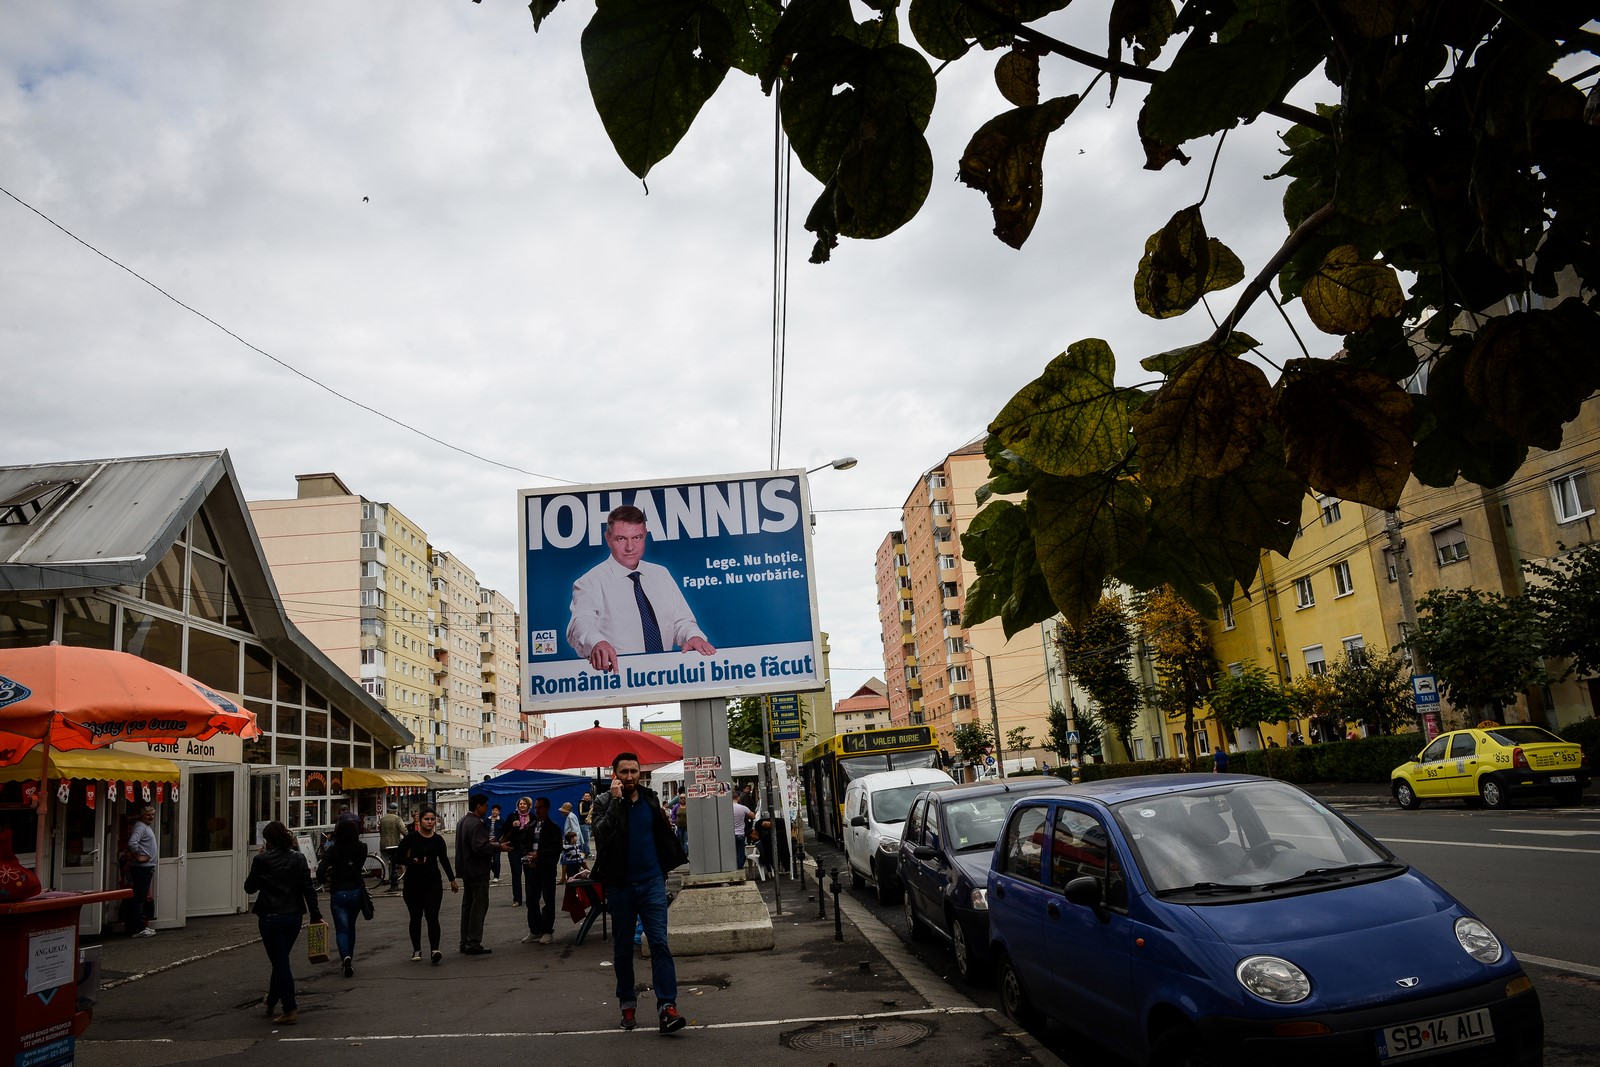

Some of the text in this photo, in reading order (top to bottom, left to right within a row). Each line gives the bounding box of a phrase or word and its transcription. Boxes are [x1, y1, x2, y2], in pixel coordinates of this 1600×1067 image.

[528, 478, 799, 550] IOHANNIS
[706, 551, 803, 571] Lege. Nu hoție.
[683, 568, 805, 589] Fapte. Nu vorbărie.
[535, 632, 554, 640] ACL
[531, 655, 814, 695] România lucrului bine făcut
[1420, 694, 1435, 702] TAXI
[127, 719, 147, 734] pe
[149, 718, 187, 732] bune
[186, 741, 215, 758] Aaron
[852, 734, 920, 750] 14 VALEA AURIE
[1495, 755, 1510, 763] 953
[1561, 754, 1576, 763] 953
[1427, 769, 1438, 778] 953
[20, 1033, 35, 1042] SUPER
[35, 1029, 49, 1038] BINGO
[1392, 1012, 1485, 1051] SB 14 ALI
[1379, 1046, 1387, 1056] RO
